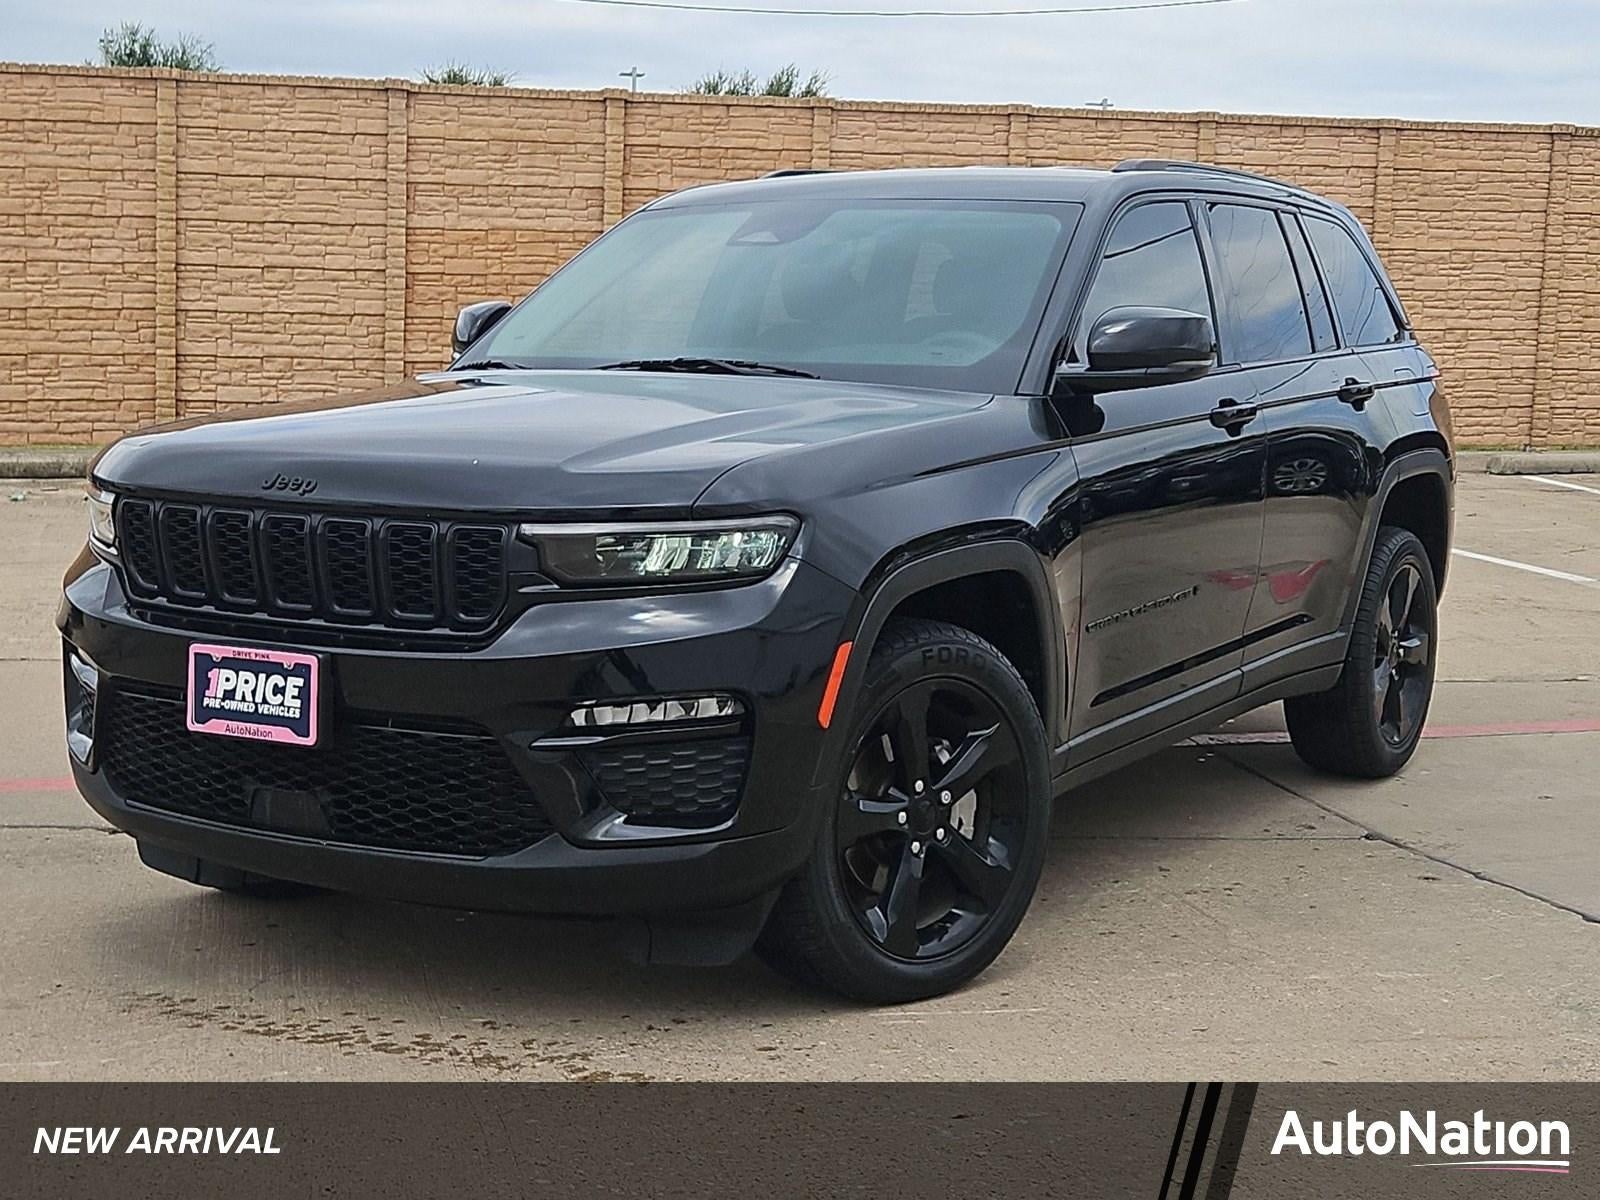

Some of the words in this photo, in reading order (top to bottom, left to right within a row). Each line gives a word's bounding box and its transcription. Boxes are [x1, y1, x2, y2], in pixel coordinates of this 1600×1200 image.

[261, 473, 318, 496] Jeep
[203, 697, 256, 713] PRE-OWNED
[257, 704, 301, 719] VEHICLES
[224, 724, 273, 739] AutoNation
